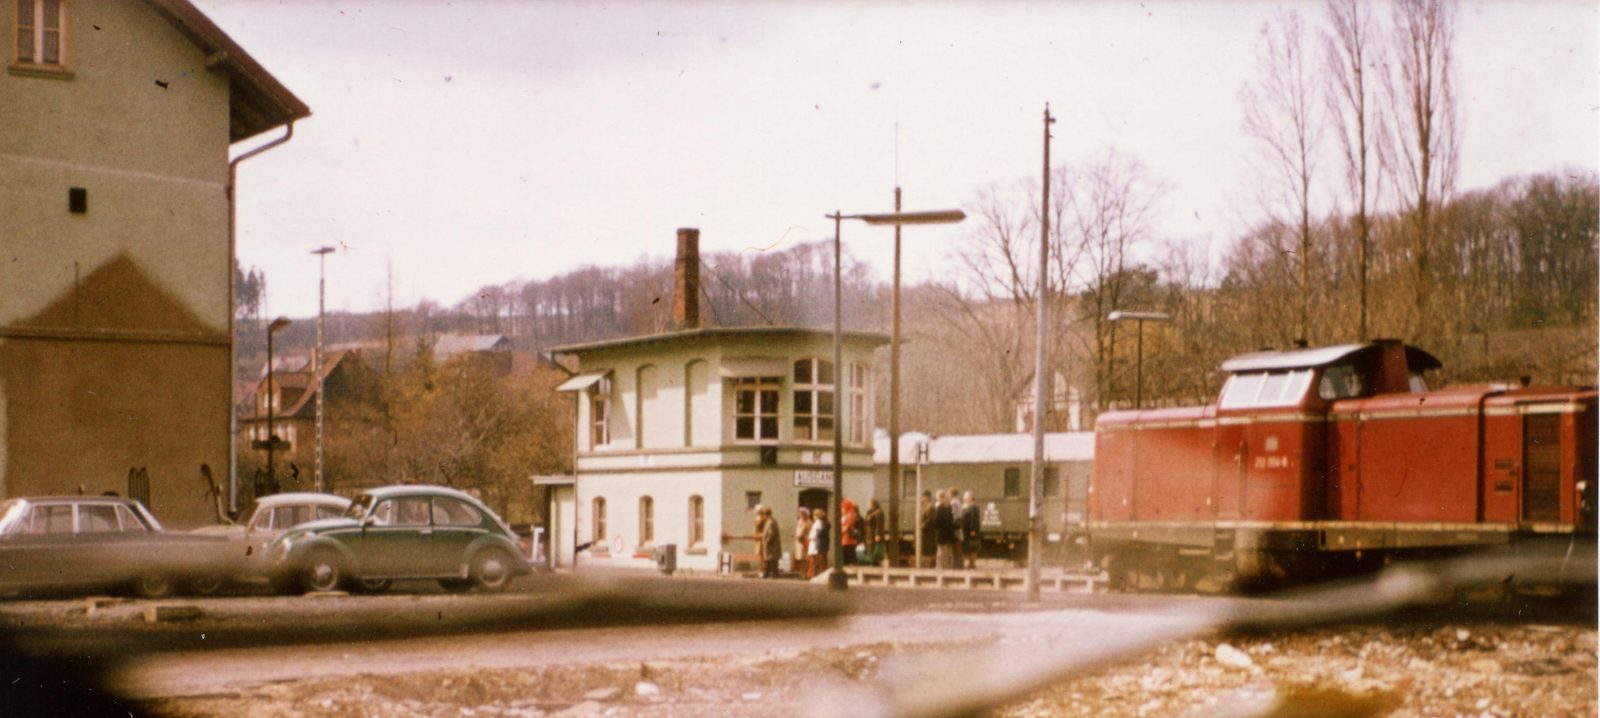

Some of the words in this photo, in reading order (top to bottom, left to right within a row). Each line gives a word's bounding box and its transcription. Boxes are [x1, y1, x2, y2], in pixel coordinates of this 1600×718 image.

[918, 442, 929, 462] H
[797, 471, 834, 482] AUSGAN
[720, 553, 732, 574] H
